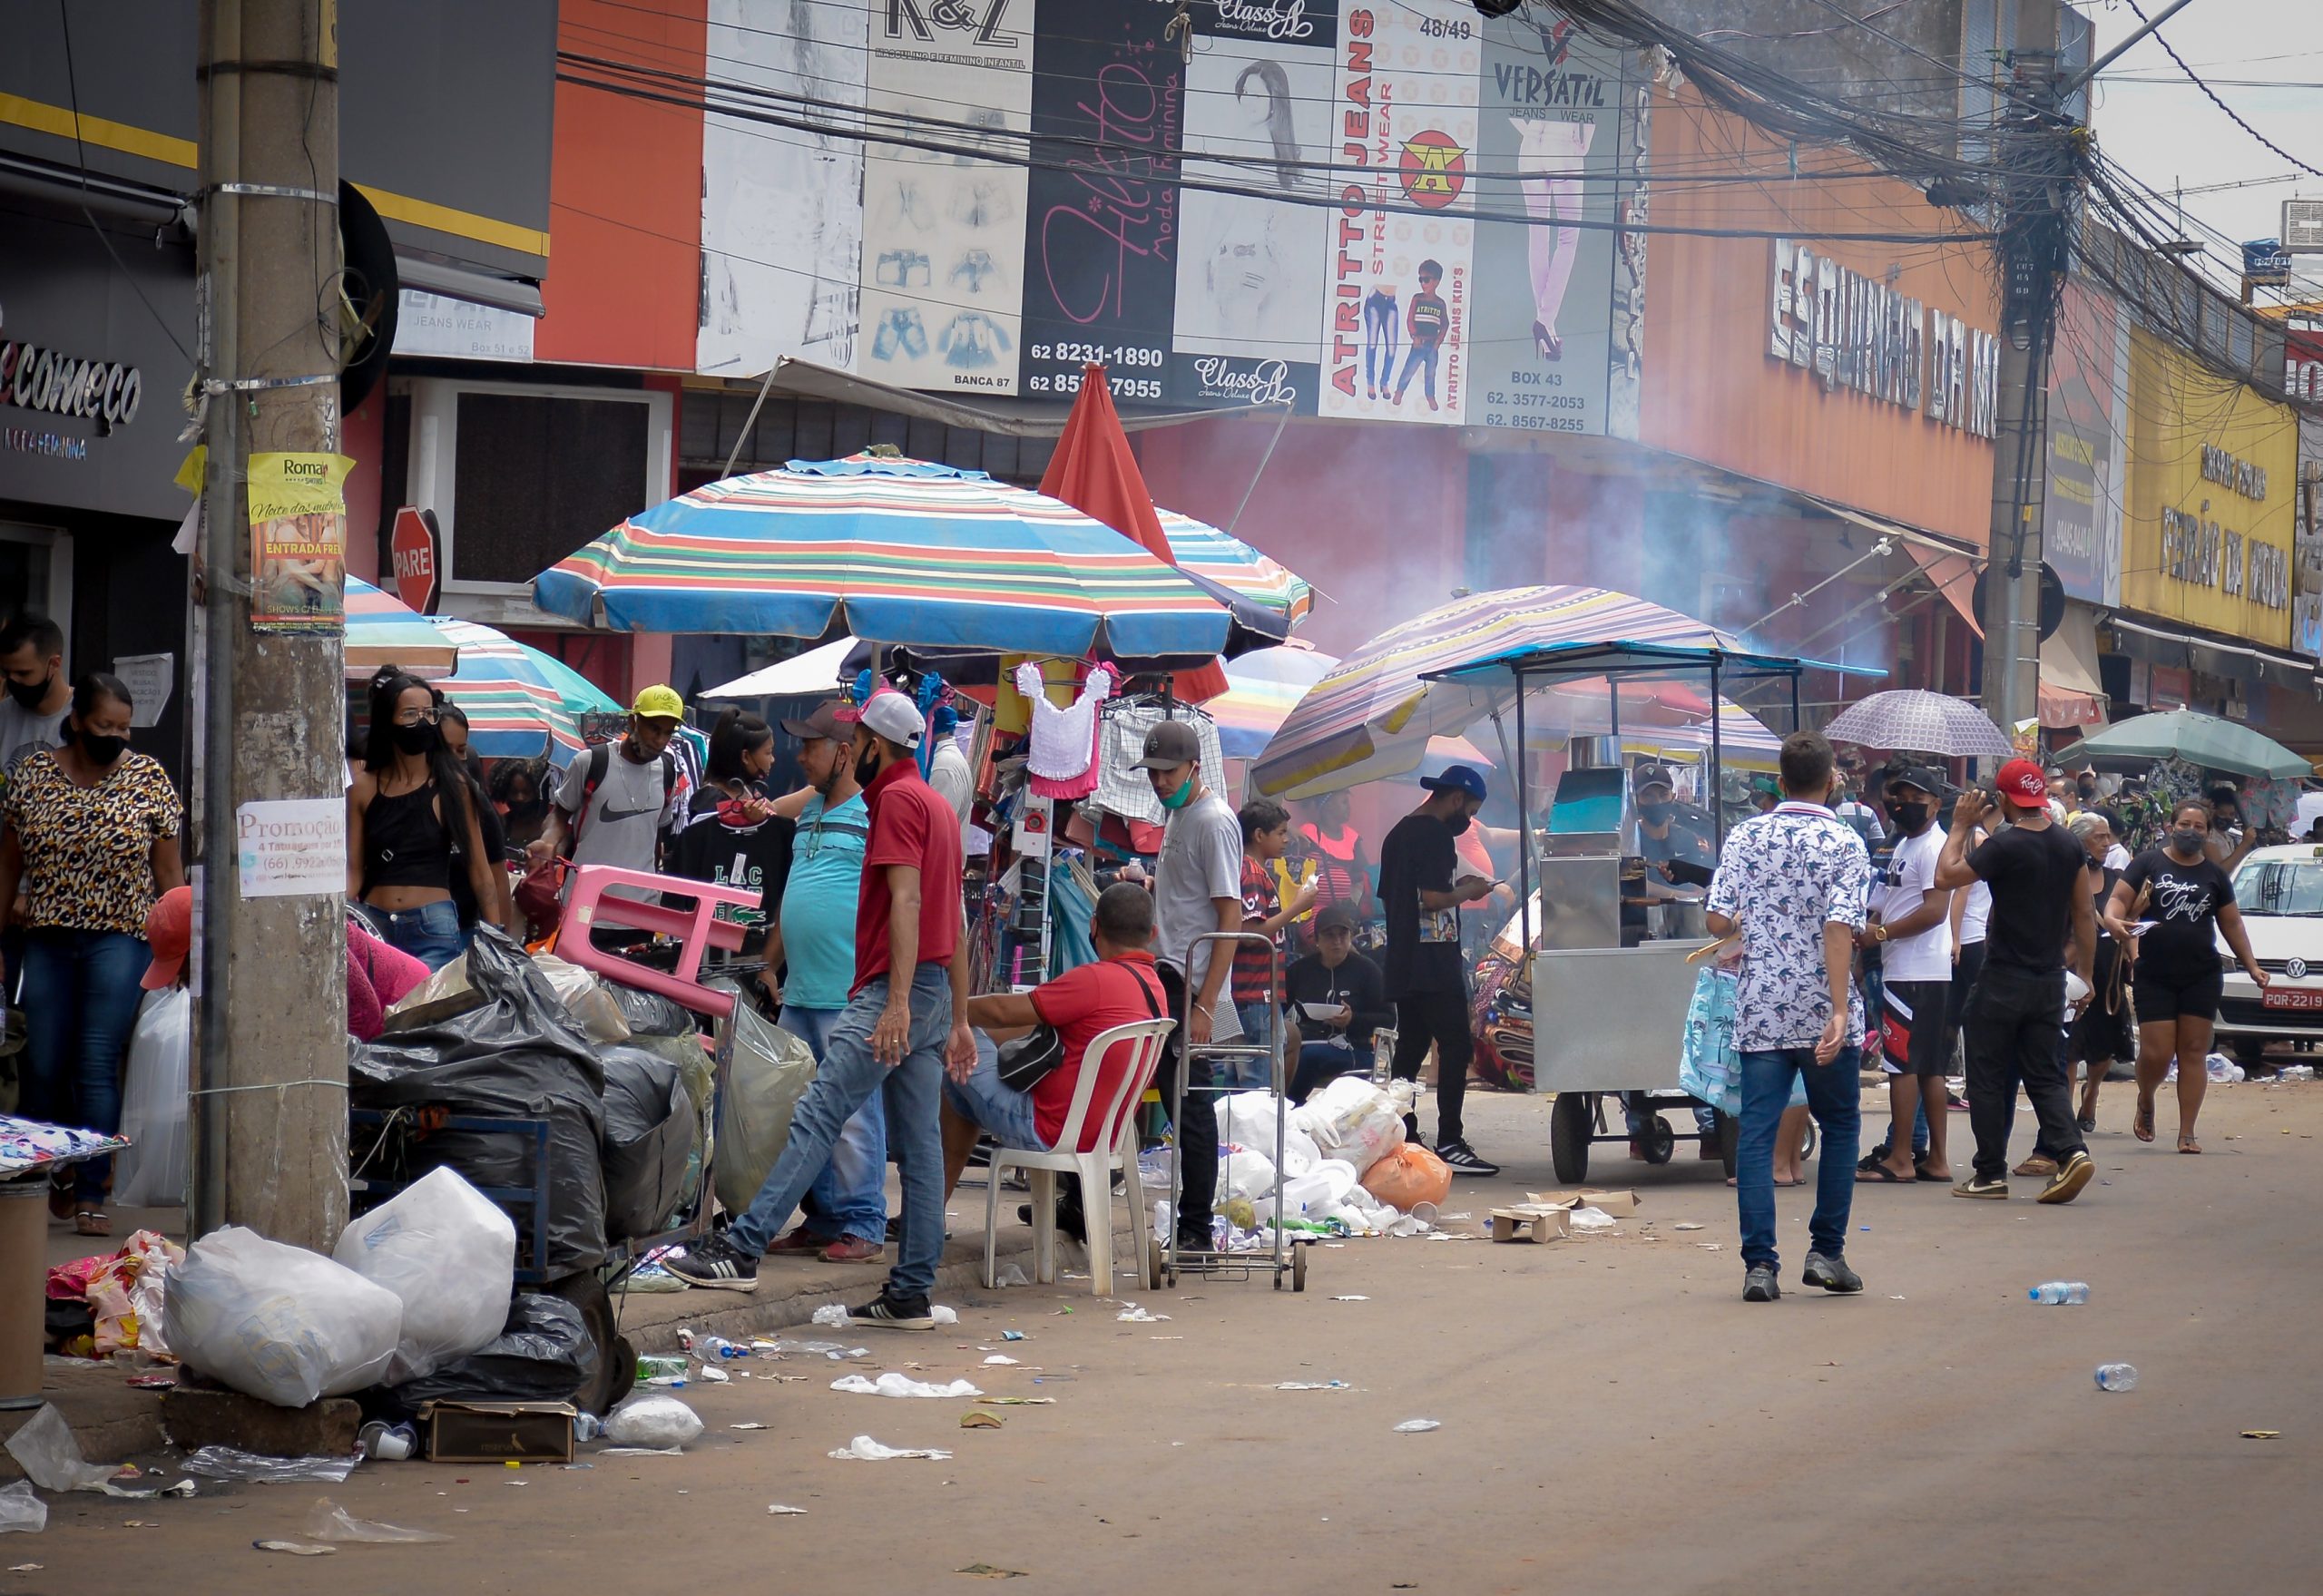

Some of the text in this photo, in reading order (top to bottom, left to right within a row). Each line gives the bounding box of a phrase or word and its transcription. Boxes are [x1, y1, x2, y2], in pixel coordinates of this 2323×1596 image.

[1419, 17, 1471, 40] 48/49
[938, 54, 983, 66] FEMININO
[985, 57, 1026, 70] INFANTIL
[1377, 83, 1392, 163] WEAR
[1509, 108, 1594, 124] JEANS WEAR
[1331, 8, 1375, 397] ATRITTO JEANS
[1152, 187, 1174, 262] Moda
[414, 317, 492, 331] JEANS WEAR
[1446, 267, 1465, 410] ATRITTO JEANS KID'S
[471, 342, 491, 352] Box
[495, 343, 505, 353] 51
[518, 345, 529, 355] 52
[1031, 342, 1163, 367] 62 8231-1890
[0, 339, 142, 437] ecomeço
[955, 375, 1010, 387] BANCA 87
[1030, 374, 1162, 398] 62 85-7955
[1512, 371, 1562, 387] BOX 43
[1486, 391, 1585, 410] 62. 3577-2053
[1486, 414, 1584, 431] 62. 8567-8255
[250, 503, 289, 519] Noite
[289, 502, 309, 514] das
[266, 543, 320, 554] ENTRADA
[396, 547, 431, 579] PARE
[267, 604, 299, 614] SHOWS
[263, 857, 289, 871] (66)
[2155, 873, 2200, 907] Sempre
